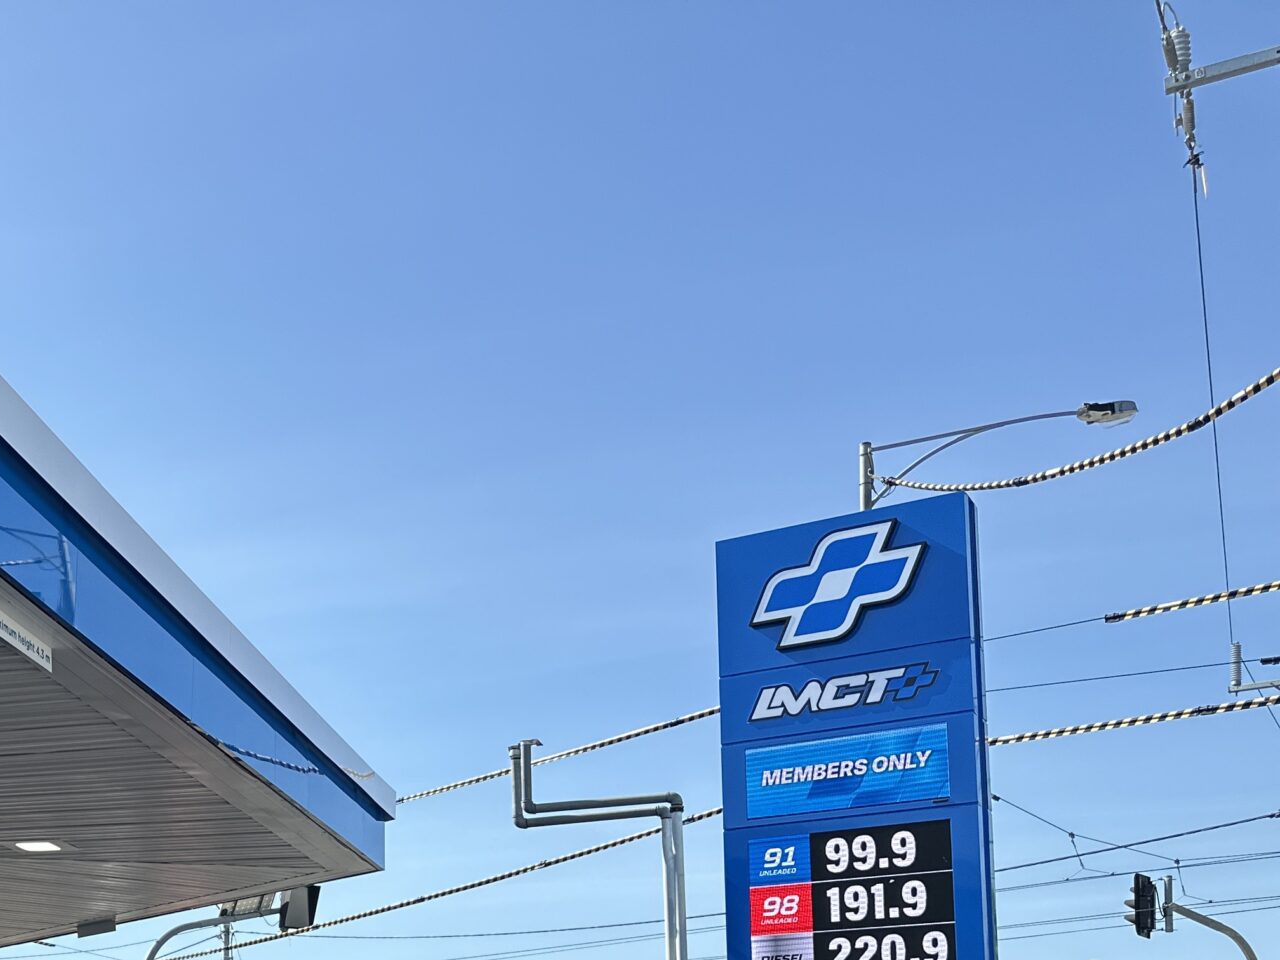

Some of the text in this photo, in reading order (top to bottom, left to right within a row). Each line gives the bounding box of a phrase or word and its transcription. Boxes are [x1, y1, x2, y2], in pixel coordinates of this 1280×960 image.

[18, 632, 36, 653] height
[761, 750, 932, 787] MEMBERS ONLY
[763, 830, 916, 874] 91 99.9
[759, 868, 797, 877] UNLEADED
[762, 879, 927, 923] 98 191.9
[761, 917, 799, 925] UNLEADED
